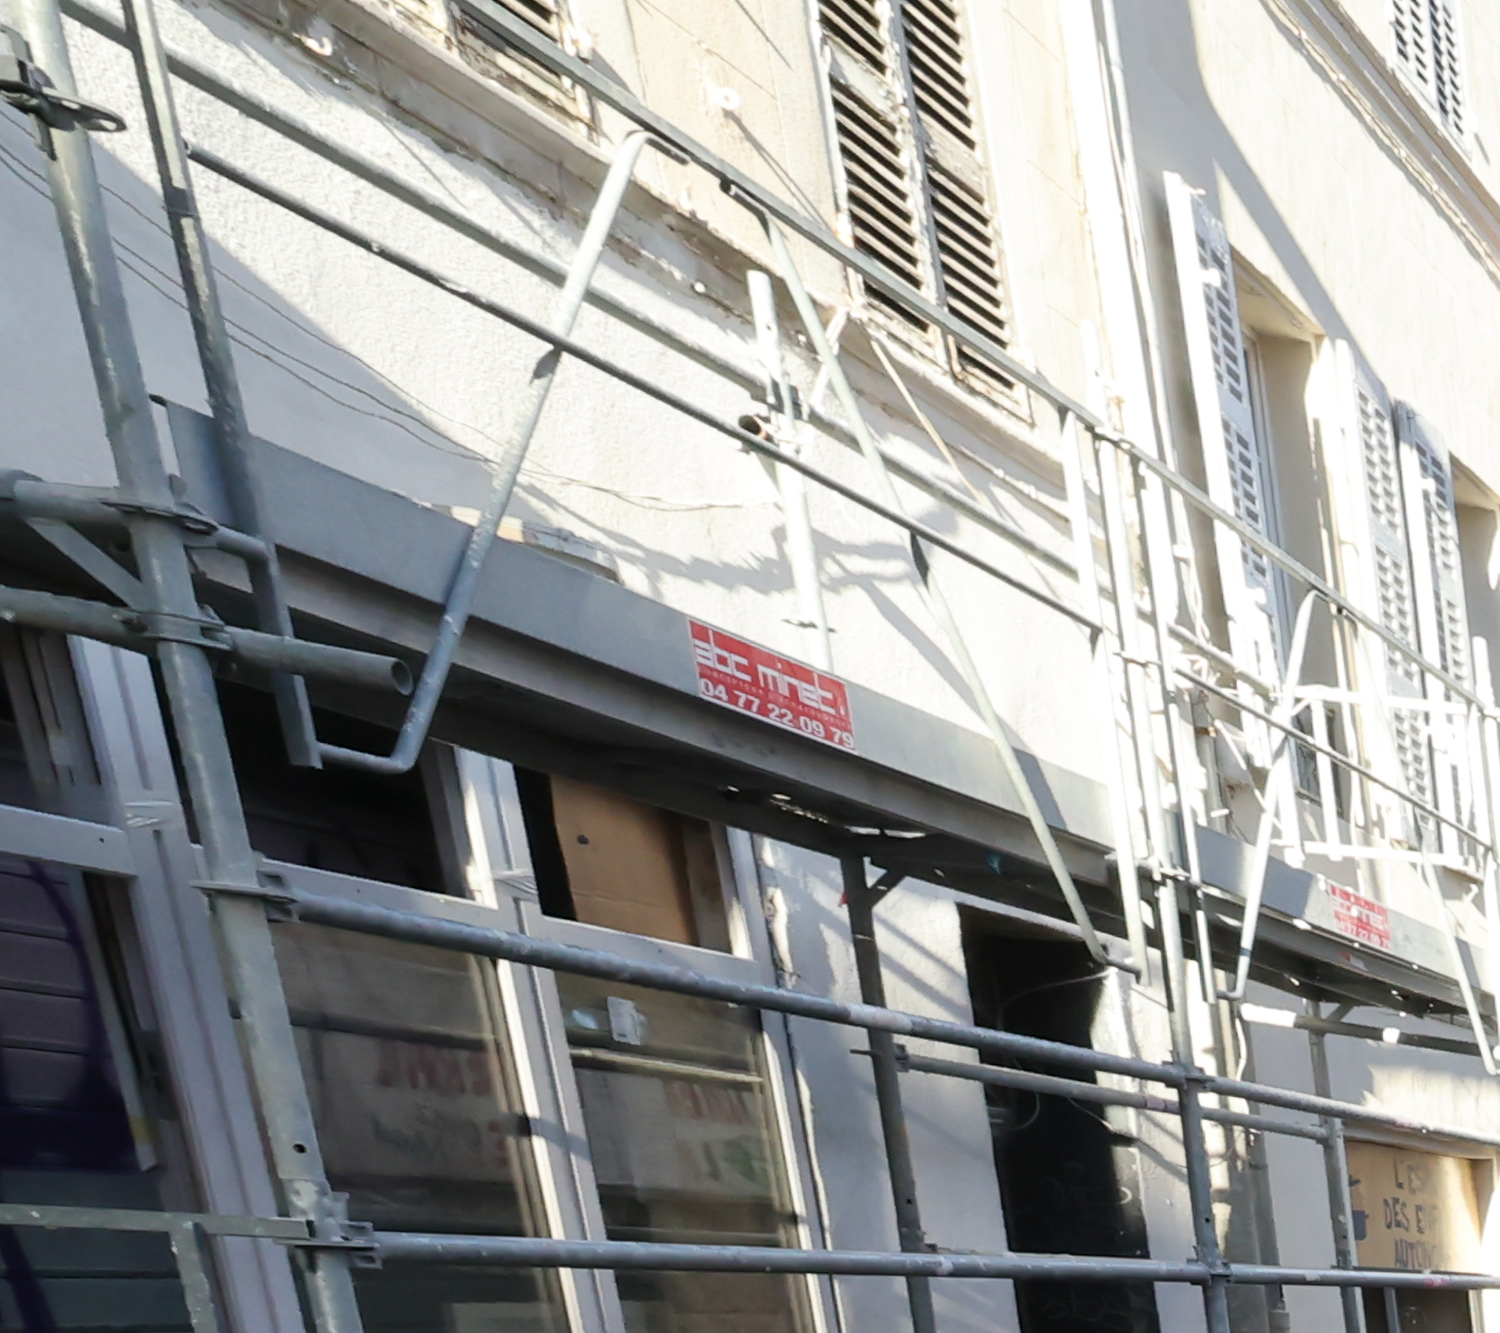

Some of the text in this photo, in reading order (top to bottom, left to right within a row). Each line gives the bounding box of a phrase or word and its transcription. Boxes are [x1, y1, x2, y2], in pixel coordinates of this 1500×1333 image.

[693, 629, 752, 683] abc
[700, 678, 729, 702] 04
[733, 690, 761, 713] 77
[767, 703, 795, 727] 22
[799, 716, 826, 737] 09
[830, 726, 855, 748] 79
